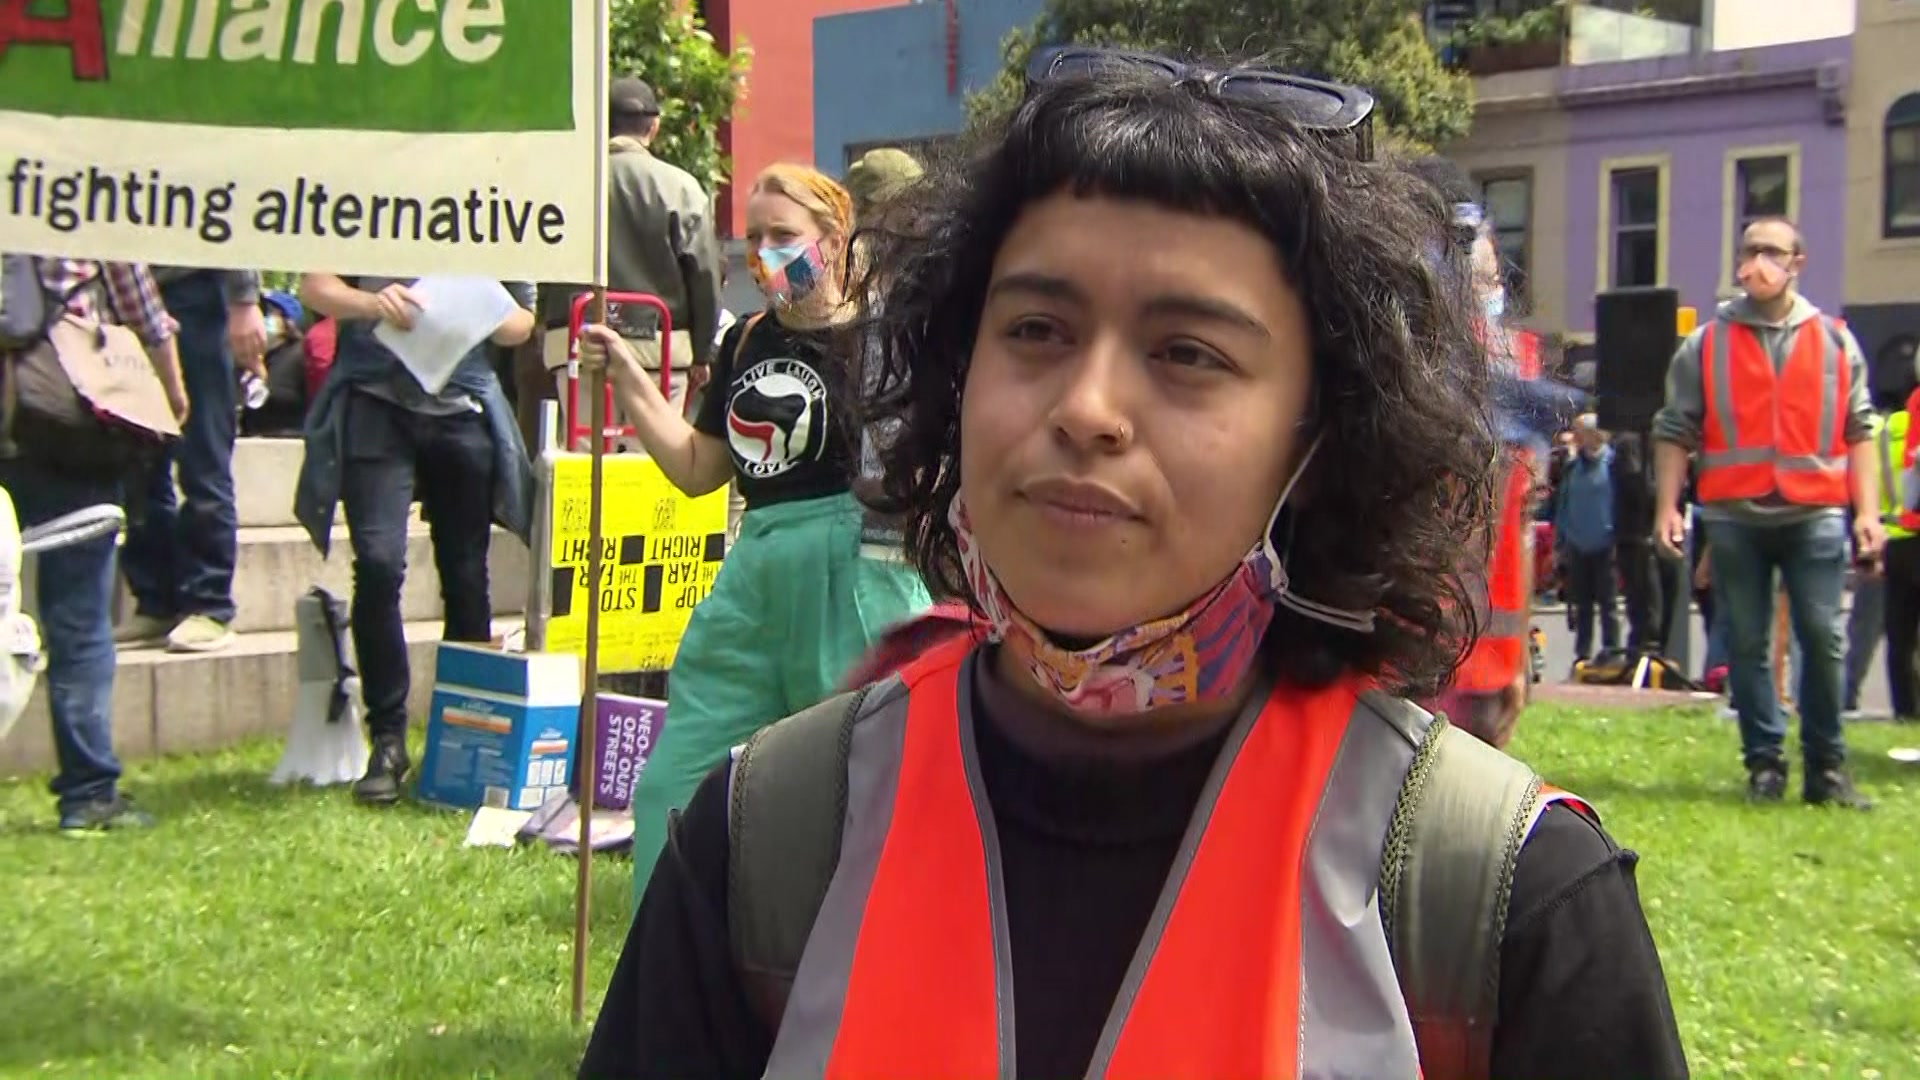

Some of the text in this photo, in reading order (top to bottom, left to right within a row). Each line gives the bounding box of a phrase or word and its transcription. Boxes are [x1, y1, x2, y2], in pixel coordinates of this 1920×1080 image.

[8, 158, 565, 244] fighting alternative
[649, 535, 702, 562] RIGHT
[667, 561, 699, 584] FAR
[618, 568, 637, 586] THE
[600, 714, 622, 795] STREETS
[613, 716, 637, 801] OFF OUR
